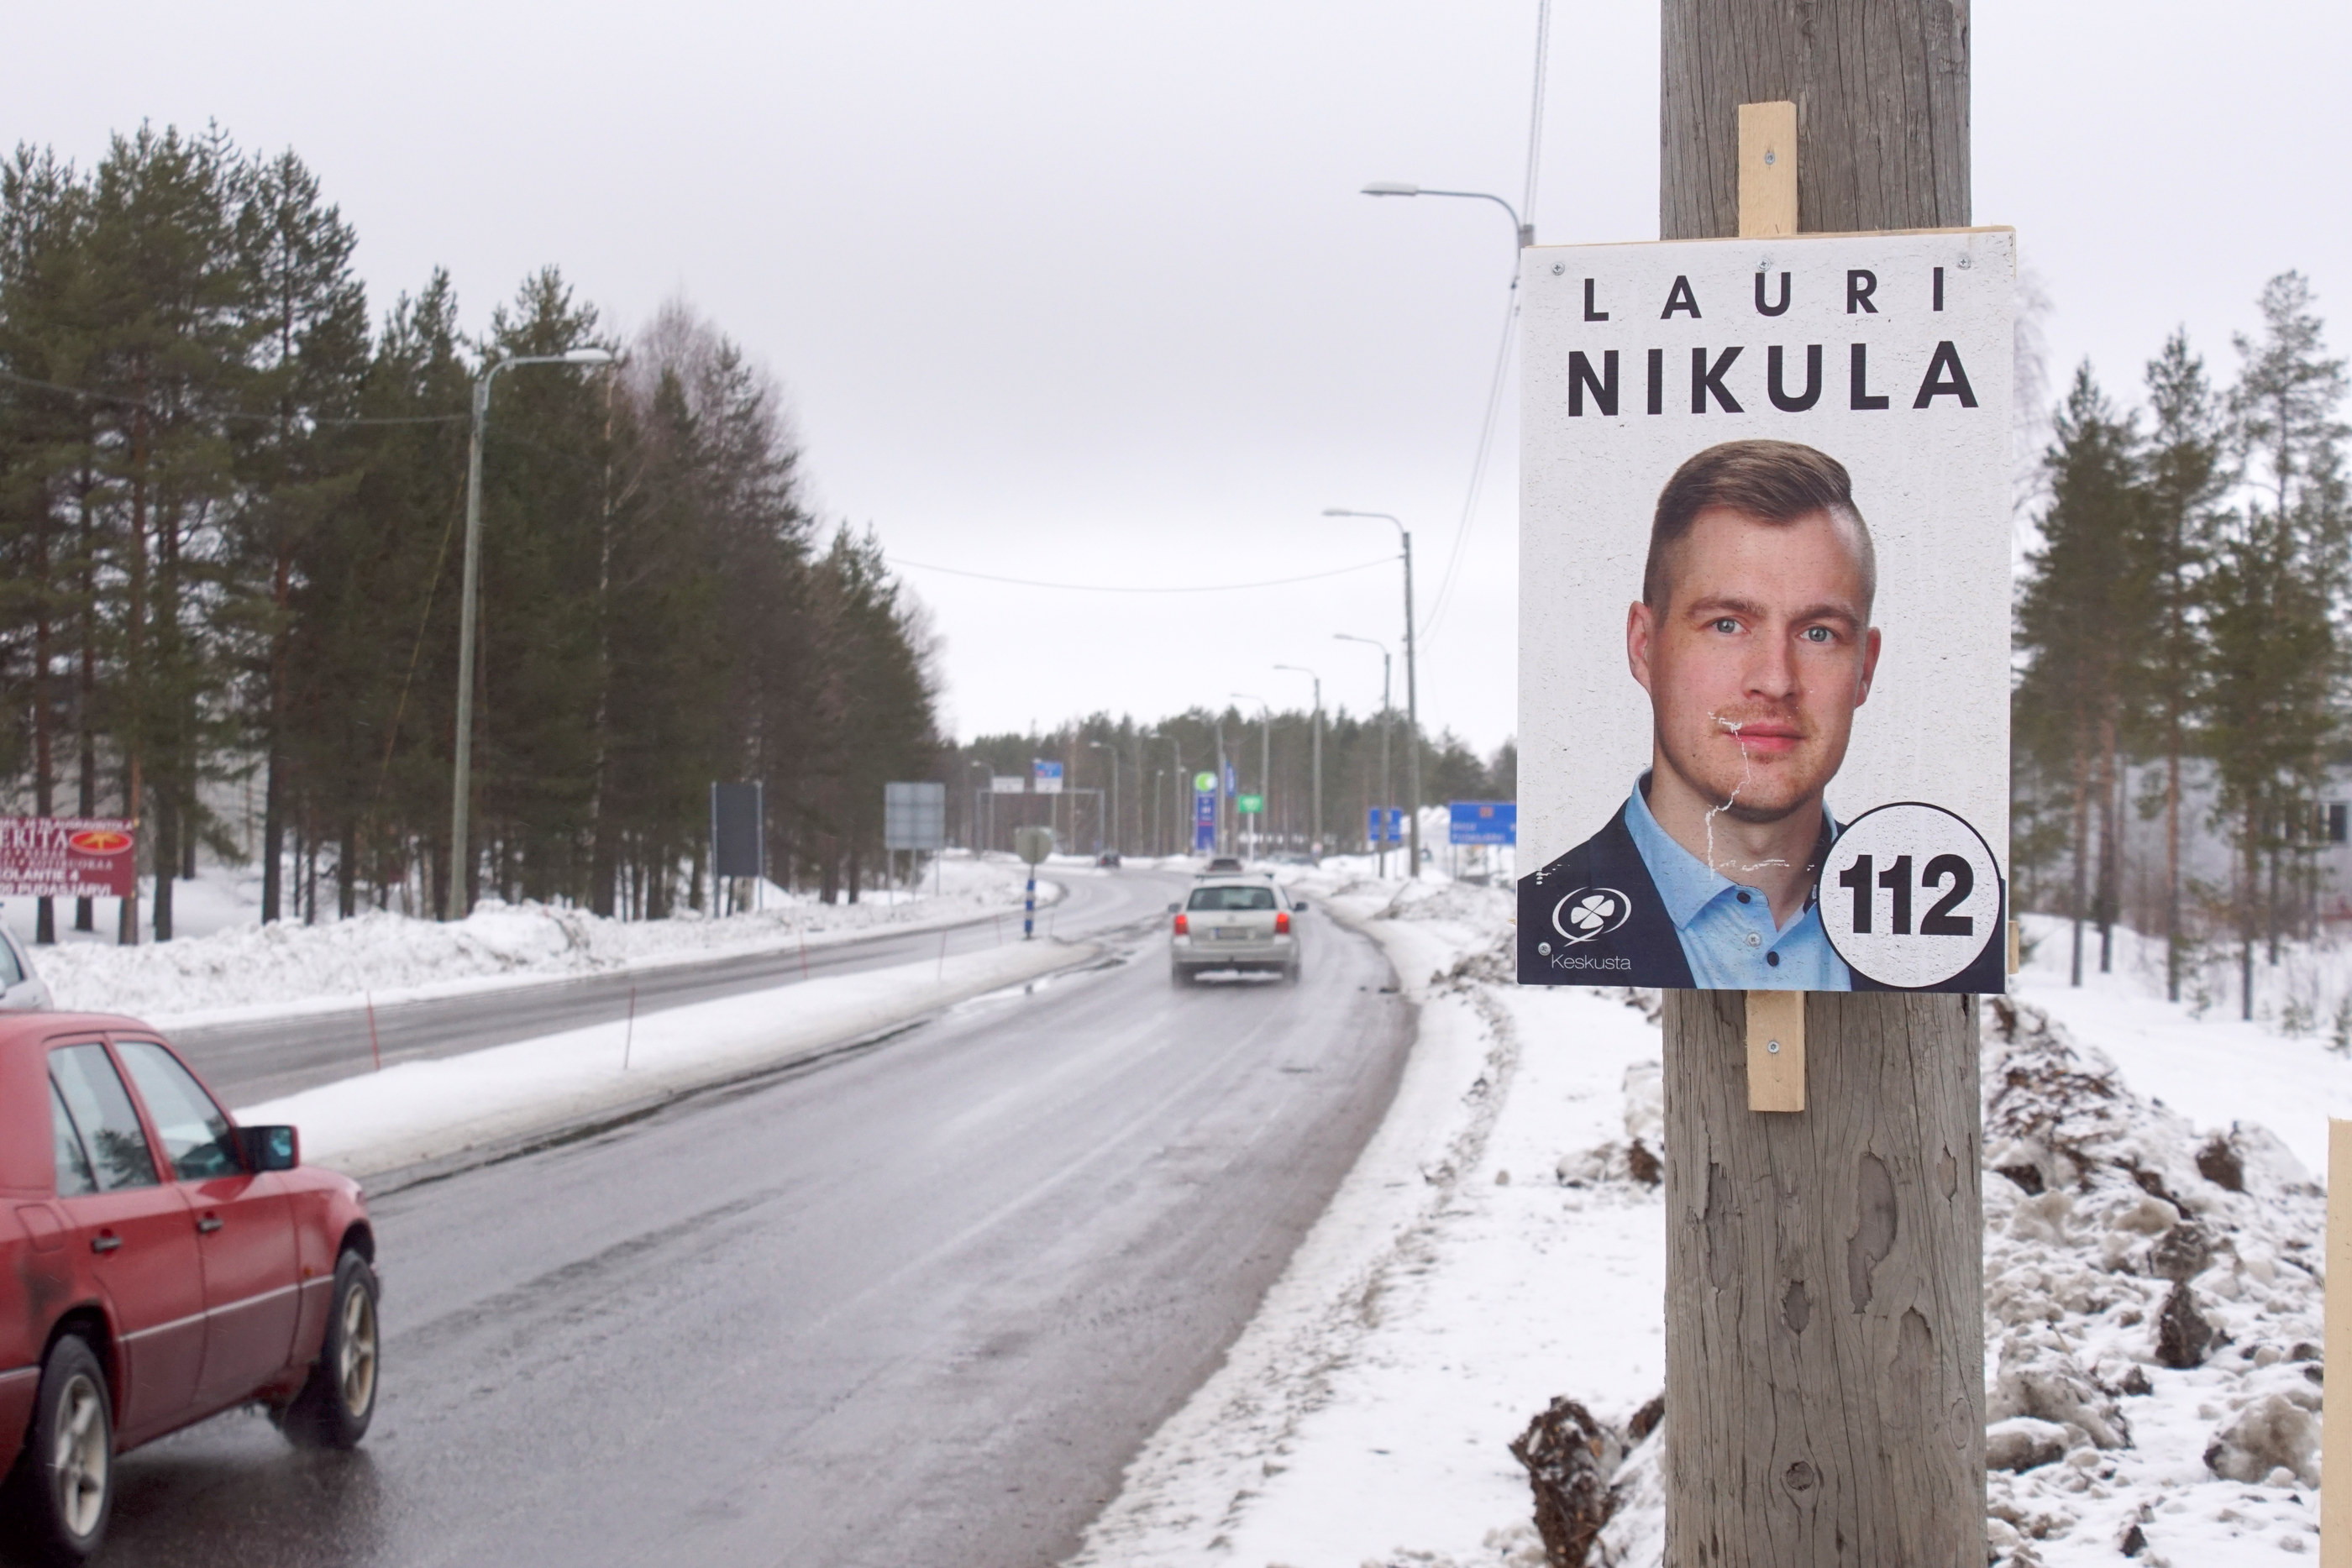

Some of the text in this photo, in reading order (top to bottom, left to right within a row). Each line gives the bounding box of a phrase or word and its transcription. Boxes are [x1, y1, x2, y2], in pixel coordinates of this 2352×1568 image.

[1584, 266, 1945, 322] LAURI
[1568, 340, 1979, 417] NIKULA
[1839, 853, 1974, 936] 112
[1551, 953, 1631, 971] Keskusta
